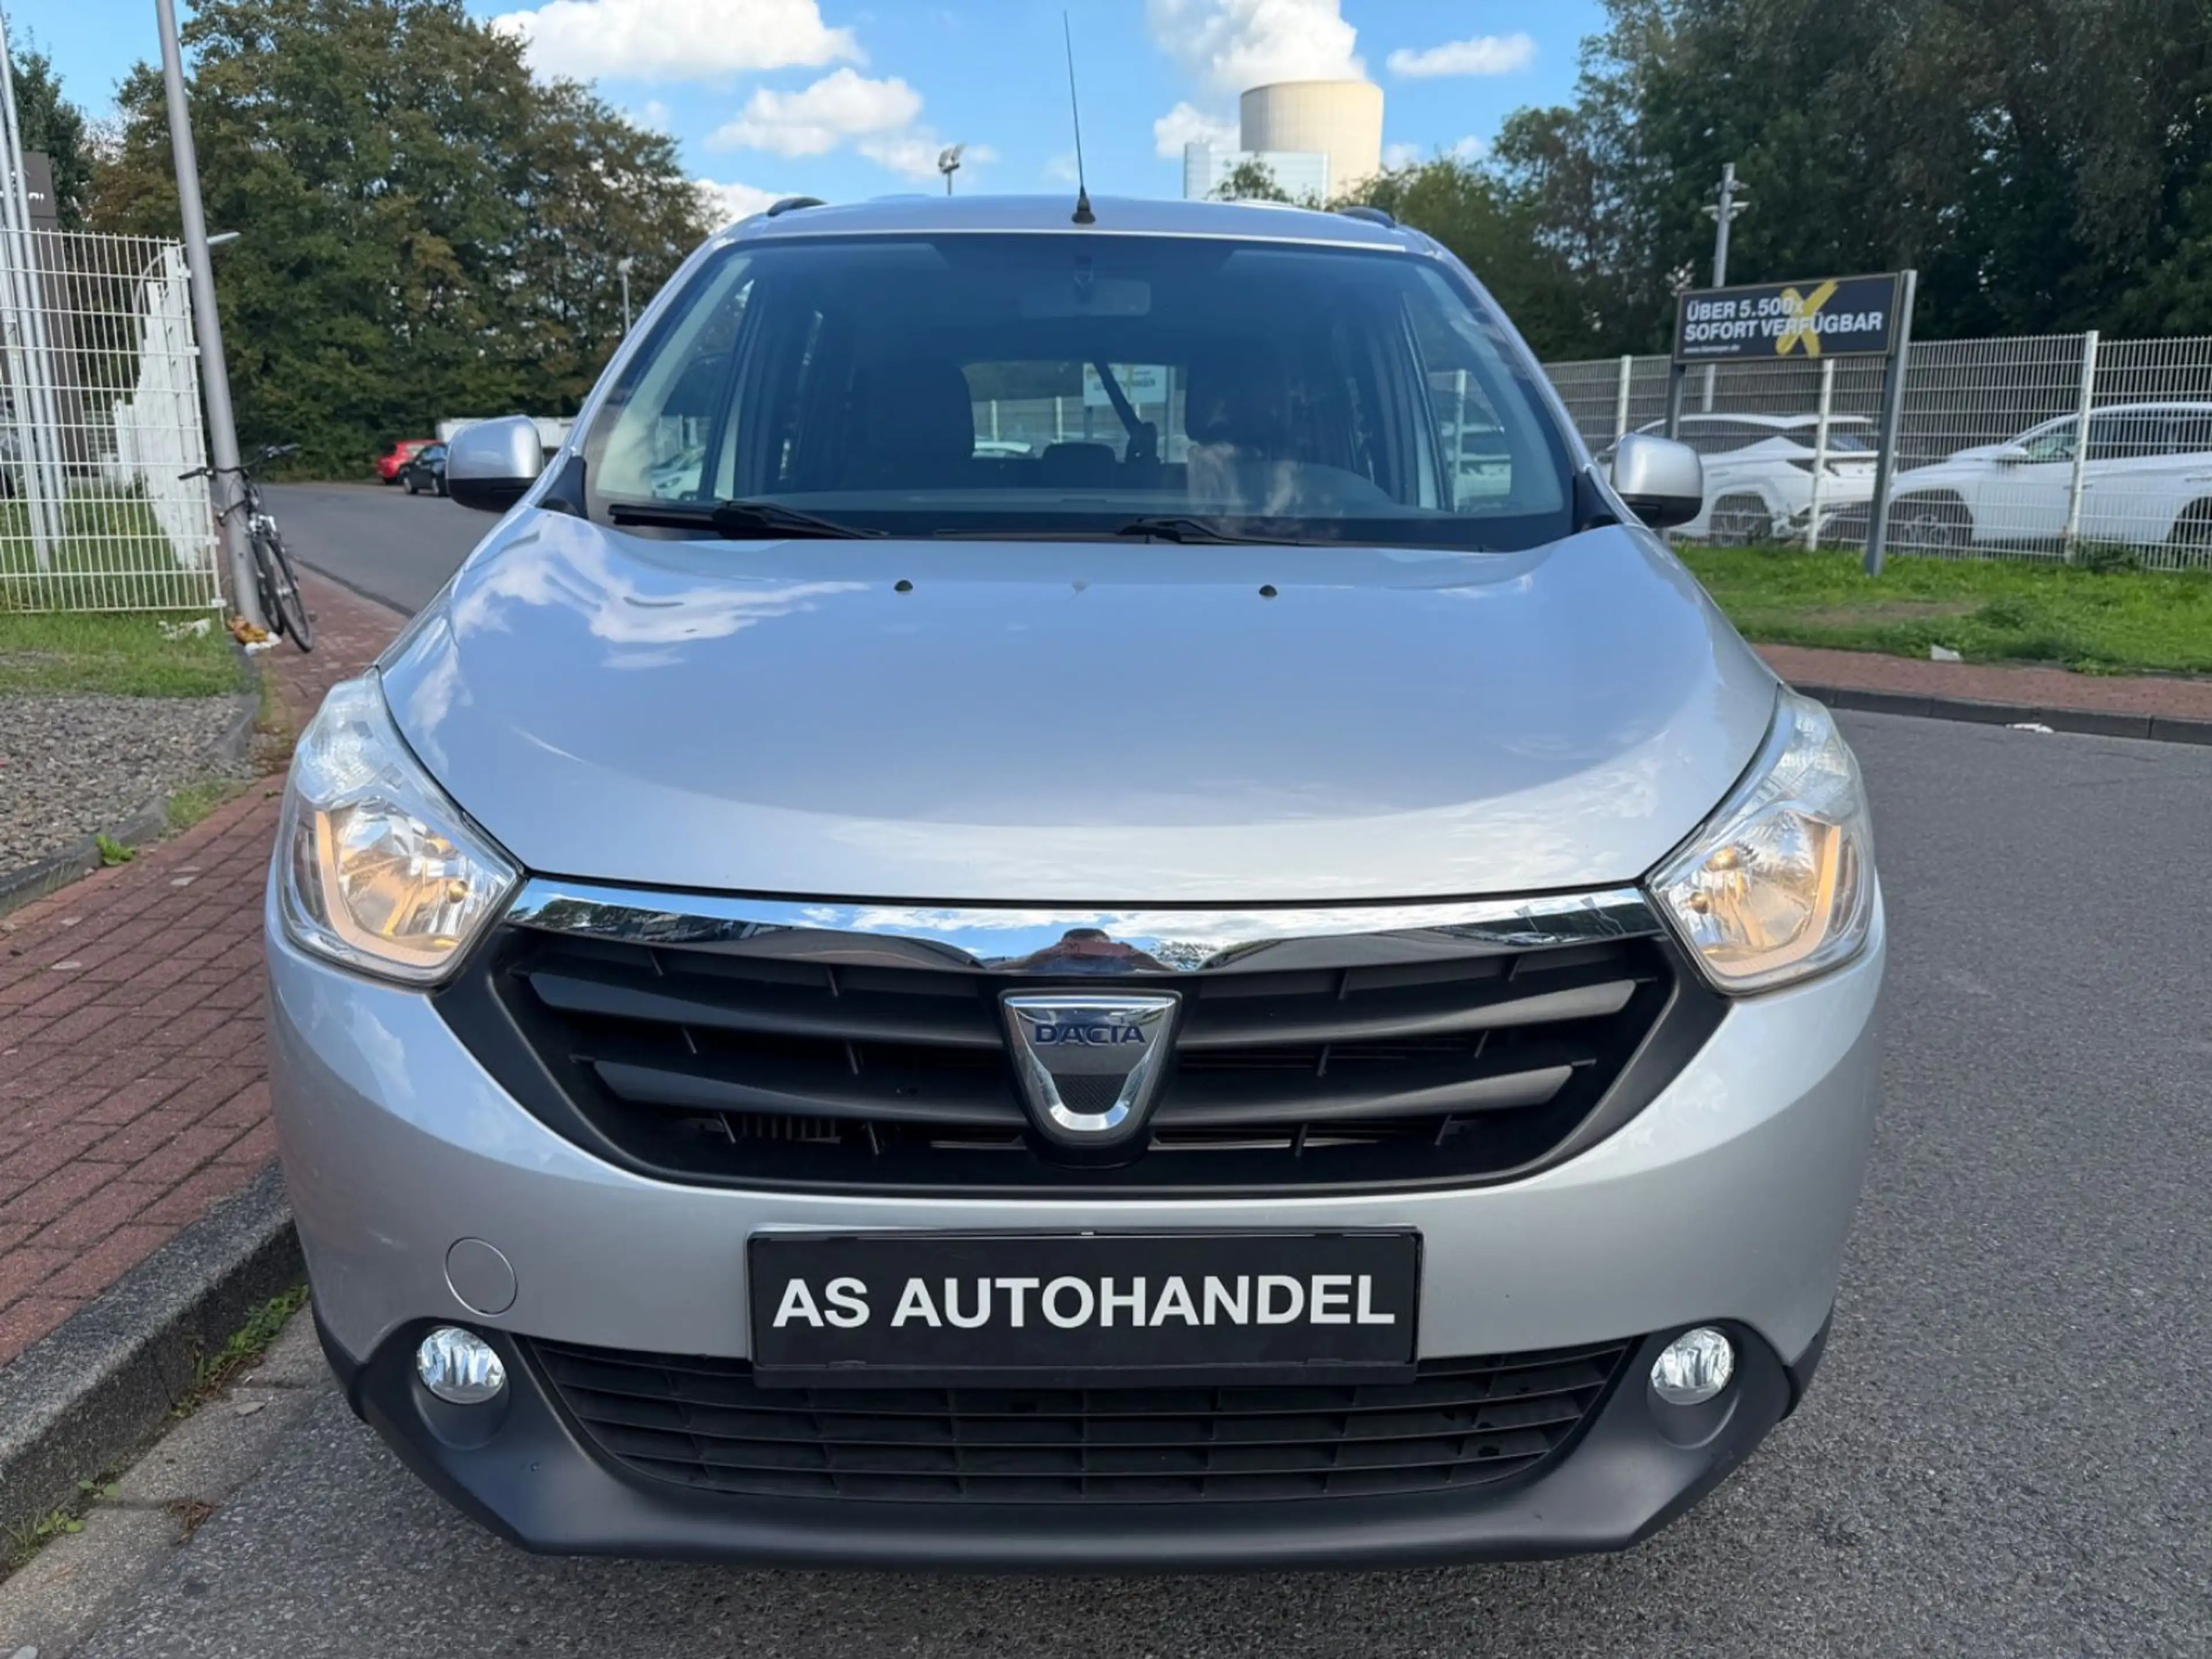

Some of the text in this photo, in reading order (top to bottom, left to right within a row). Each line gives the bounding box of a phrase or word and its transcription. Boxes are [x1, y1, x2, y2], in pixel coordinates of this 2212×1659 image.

[1687, 300, 1737, 321] ÜBER
[1684, 311, 1883, 342] SOFORT VERFÜGBAR
[1035, 1023, 1146, 1046] DACIA
[772, 1275, 1395, 1328] AS AUTOHANDEL
